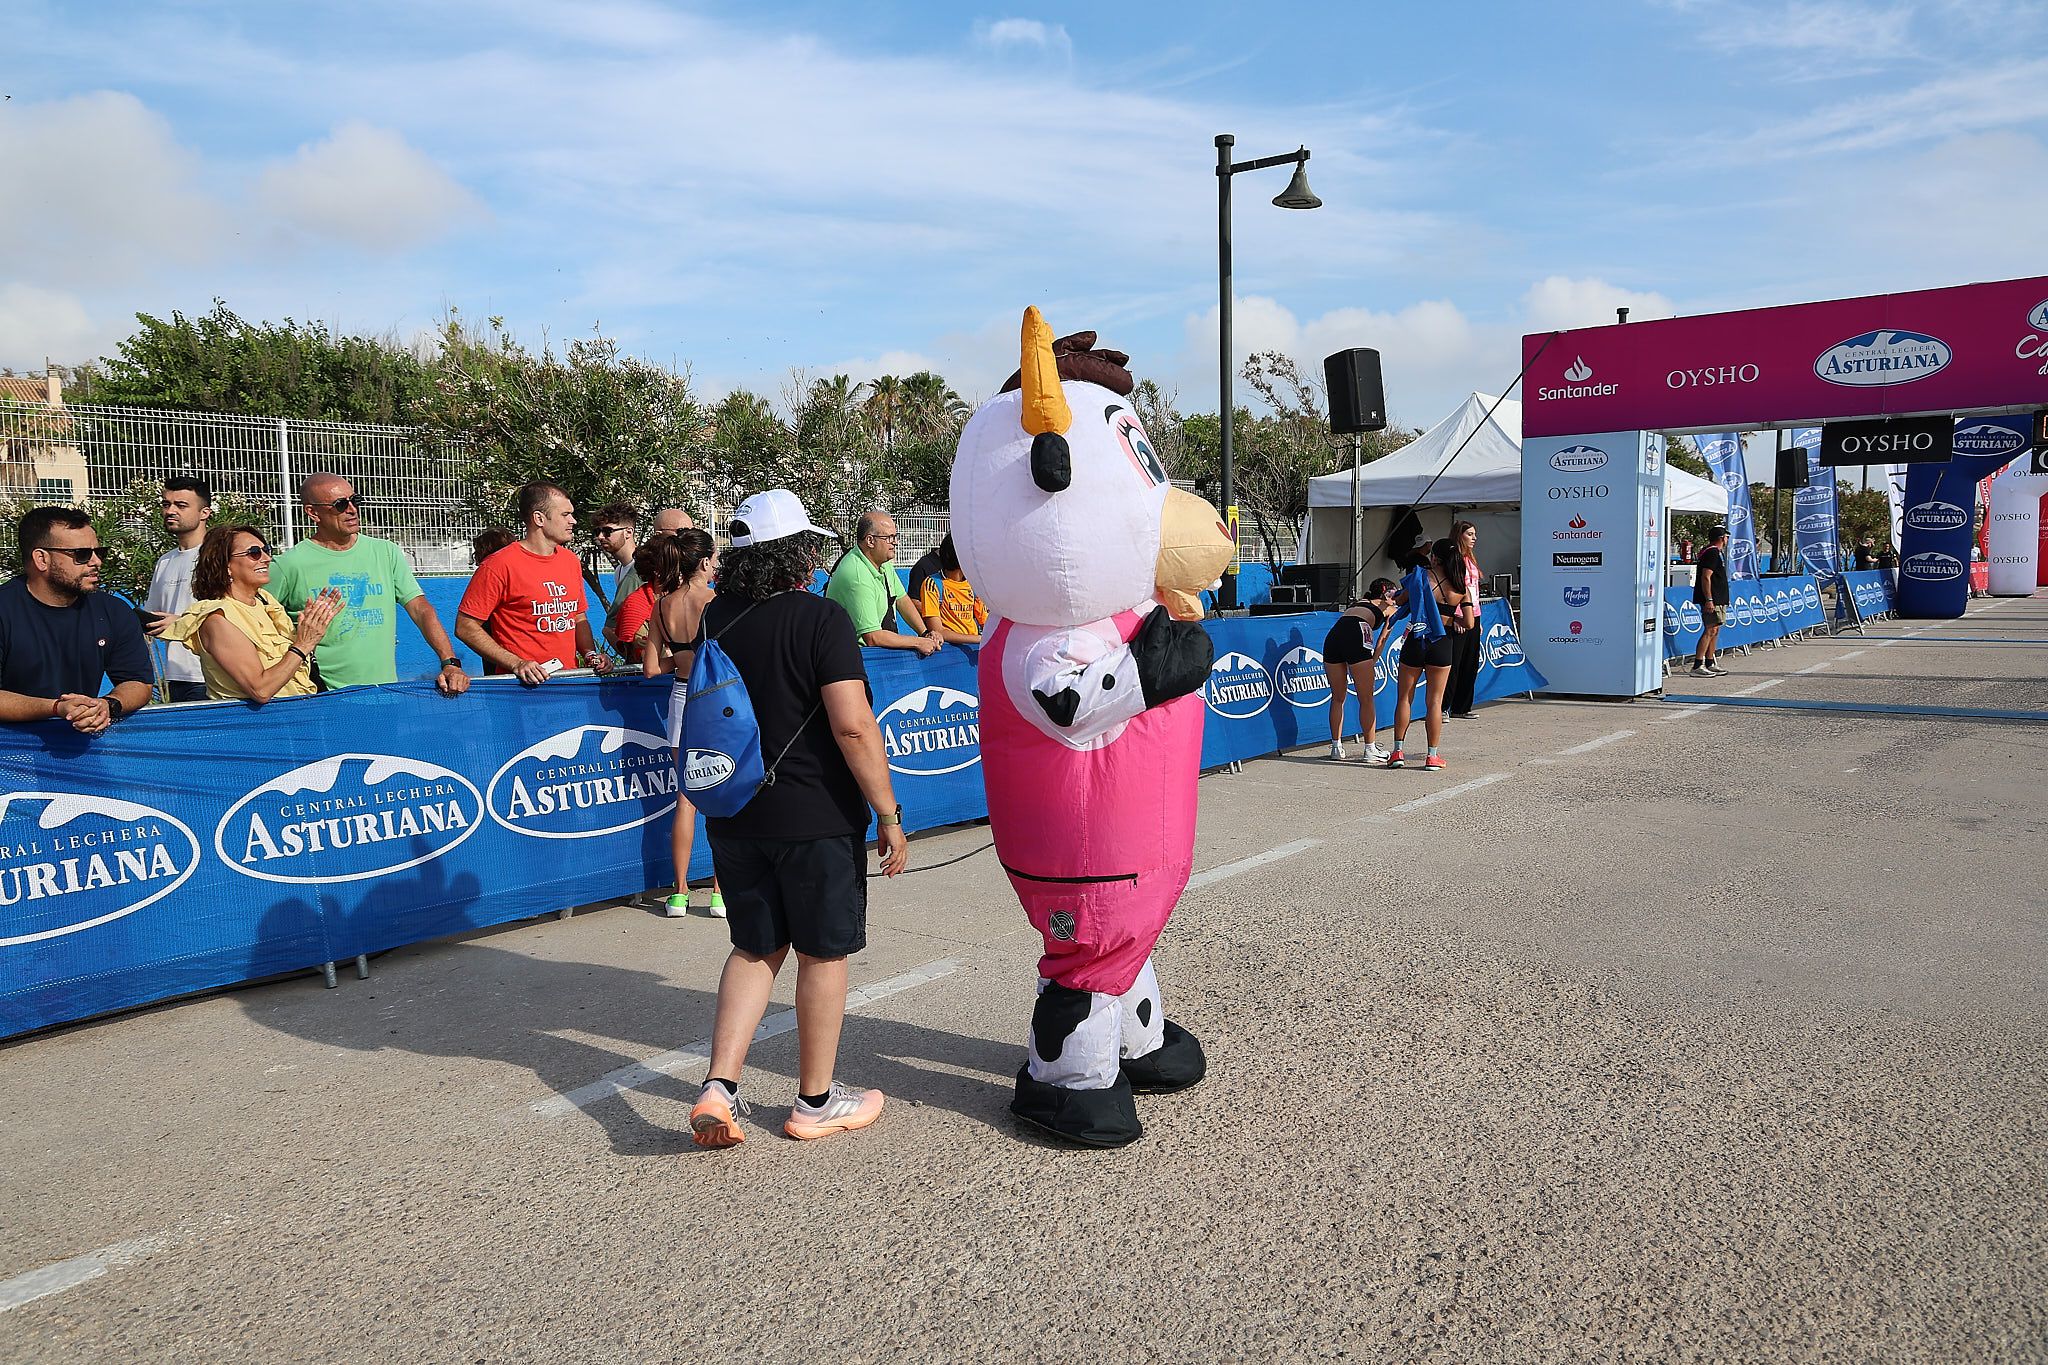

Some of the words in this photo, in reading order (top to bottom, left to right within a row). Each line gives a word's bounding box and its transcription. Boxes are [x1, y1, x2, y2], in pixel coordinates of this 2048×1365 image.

[1844, 348, 1887, 358] CENTRAL
[1892, 344, 1937, 354] LECHERA
[1823, 352, 1941, 376] ASTURIANA
[1666, 363, 1760, 389] OYSHO
[1538, 382, 1619, 401] Santander
[1841, 432, 1933, 453] OYSHO
[1553, 456, 1604, 467] ASTURIANA
[1548, 484, 1609, 500] OYSHO
[1908, 512, 1963, 524] ASTURIANA
[1994, 513, 2031, 521] OYSHO
[1552, 530, 1603, 540] Santander
[1556, 555, 1599, 565] Neutrogena
[1992, 556, 2029, 564] OYSHO
[1904, 562, 1959, 575] ASTURIANA
[543, 581, 567, 597] The
[1549, 636, 1578, 645] octopus
[1211, 680, 1271, 706] ASTURIANA
[900, 715, 942, 729] CENTRAL
[536, 761, 604, 781] CENTRAL
[609, 752, 673, 770] LECHERA
[280, 794, 367, 818] CENTRAL
[374, 783, 455, 804] LECHERA
[506, 767, 678, 820] ASTURIANA
[54, 824, 162, 851] LECHERA
[241, 799, 469, 864] ASTURIANA
